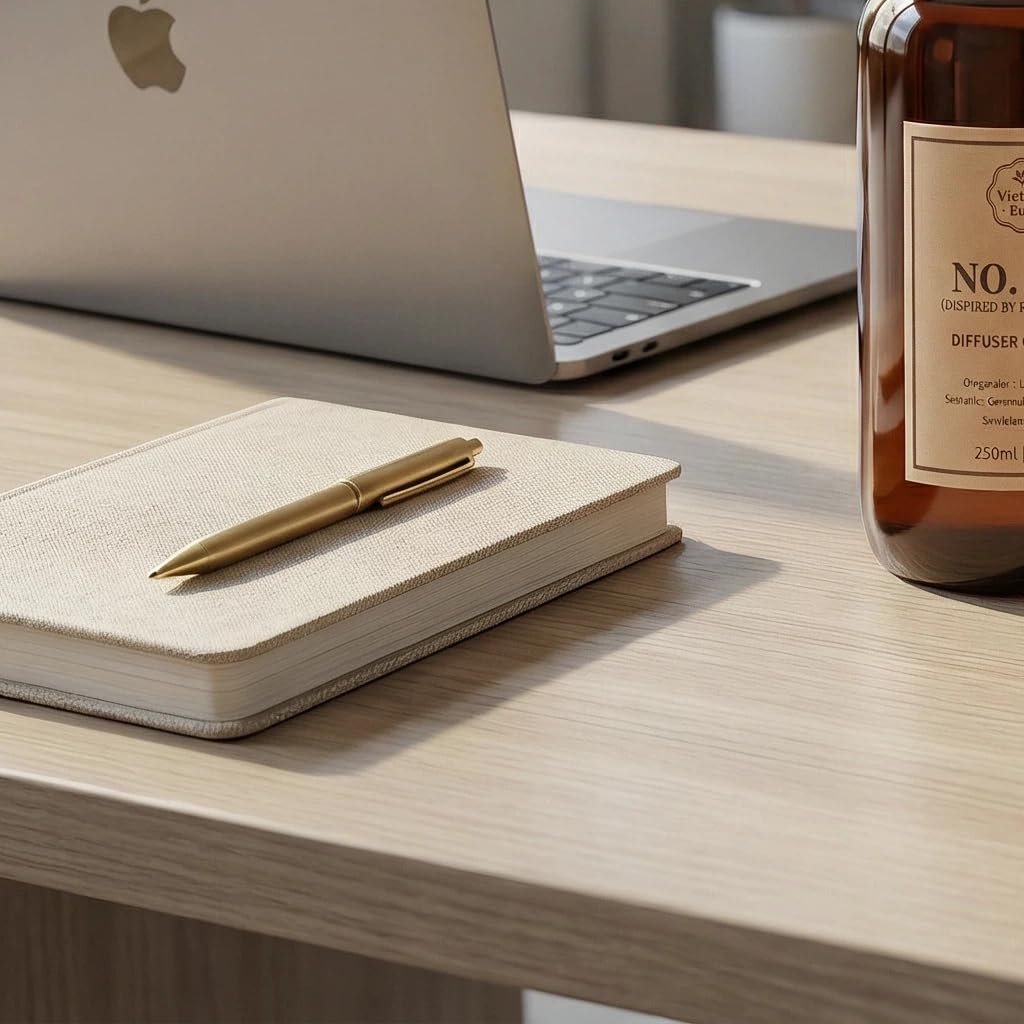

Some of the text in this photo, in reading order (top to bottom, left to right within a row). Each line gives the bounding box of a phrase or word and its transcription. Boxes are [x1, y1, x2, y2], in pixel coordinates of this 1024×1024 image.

[951, 261, 1017, 295] NO.
[1001, 301, 1016, 313] BY
[951, 333, 1018, 349] DIFFUSER
[974, 445, 1018, 461] 250ml
